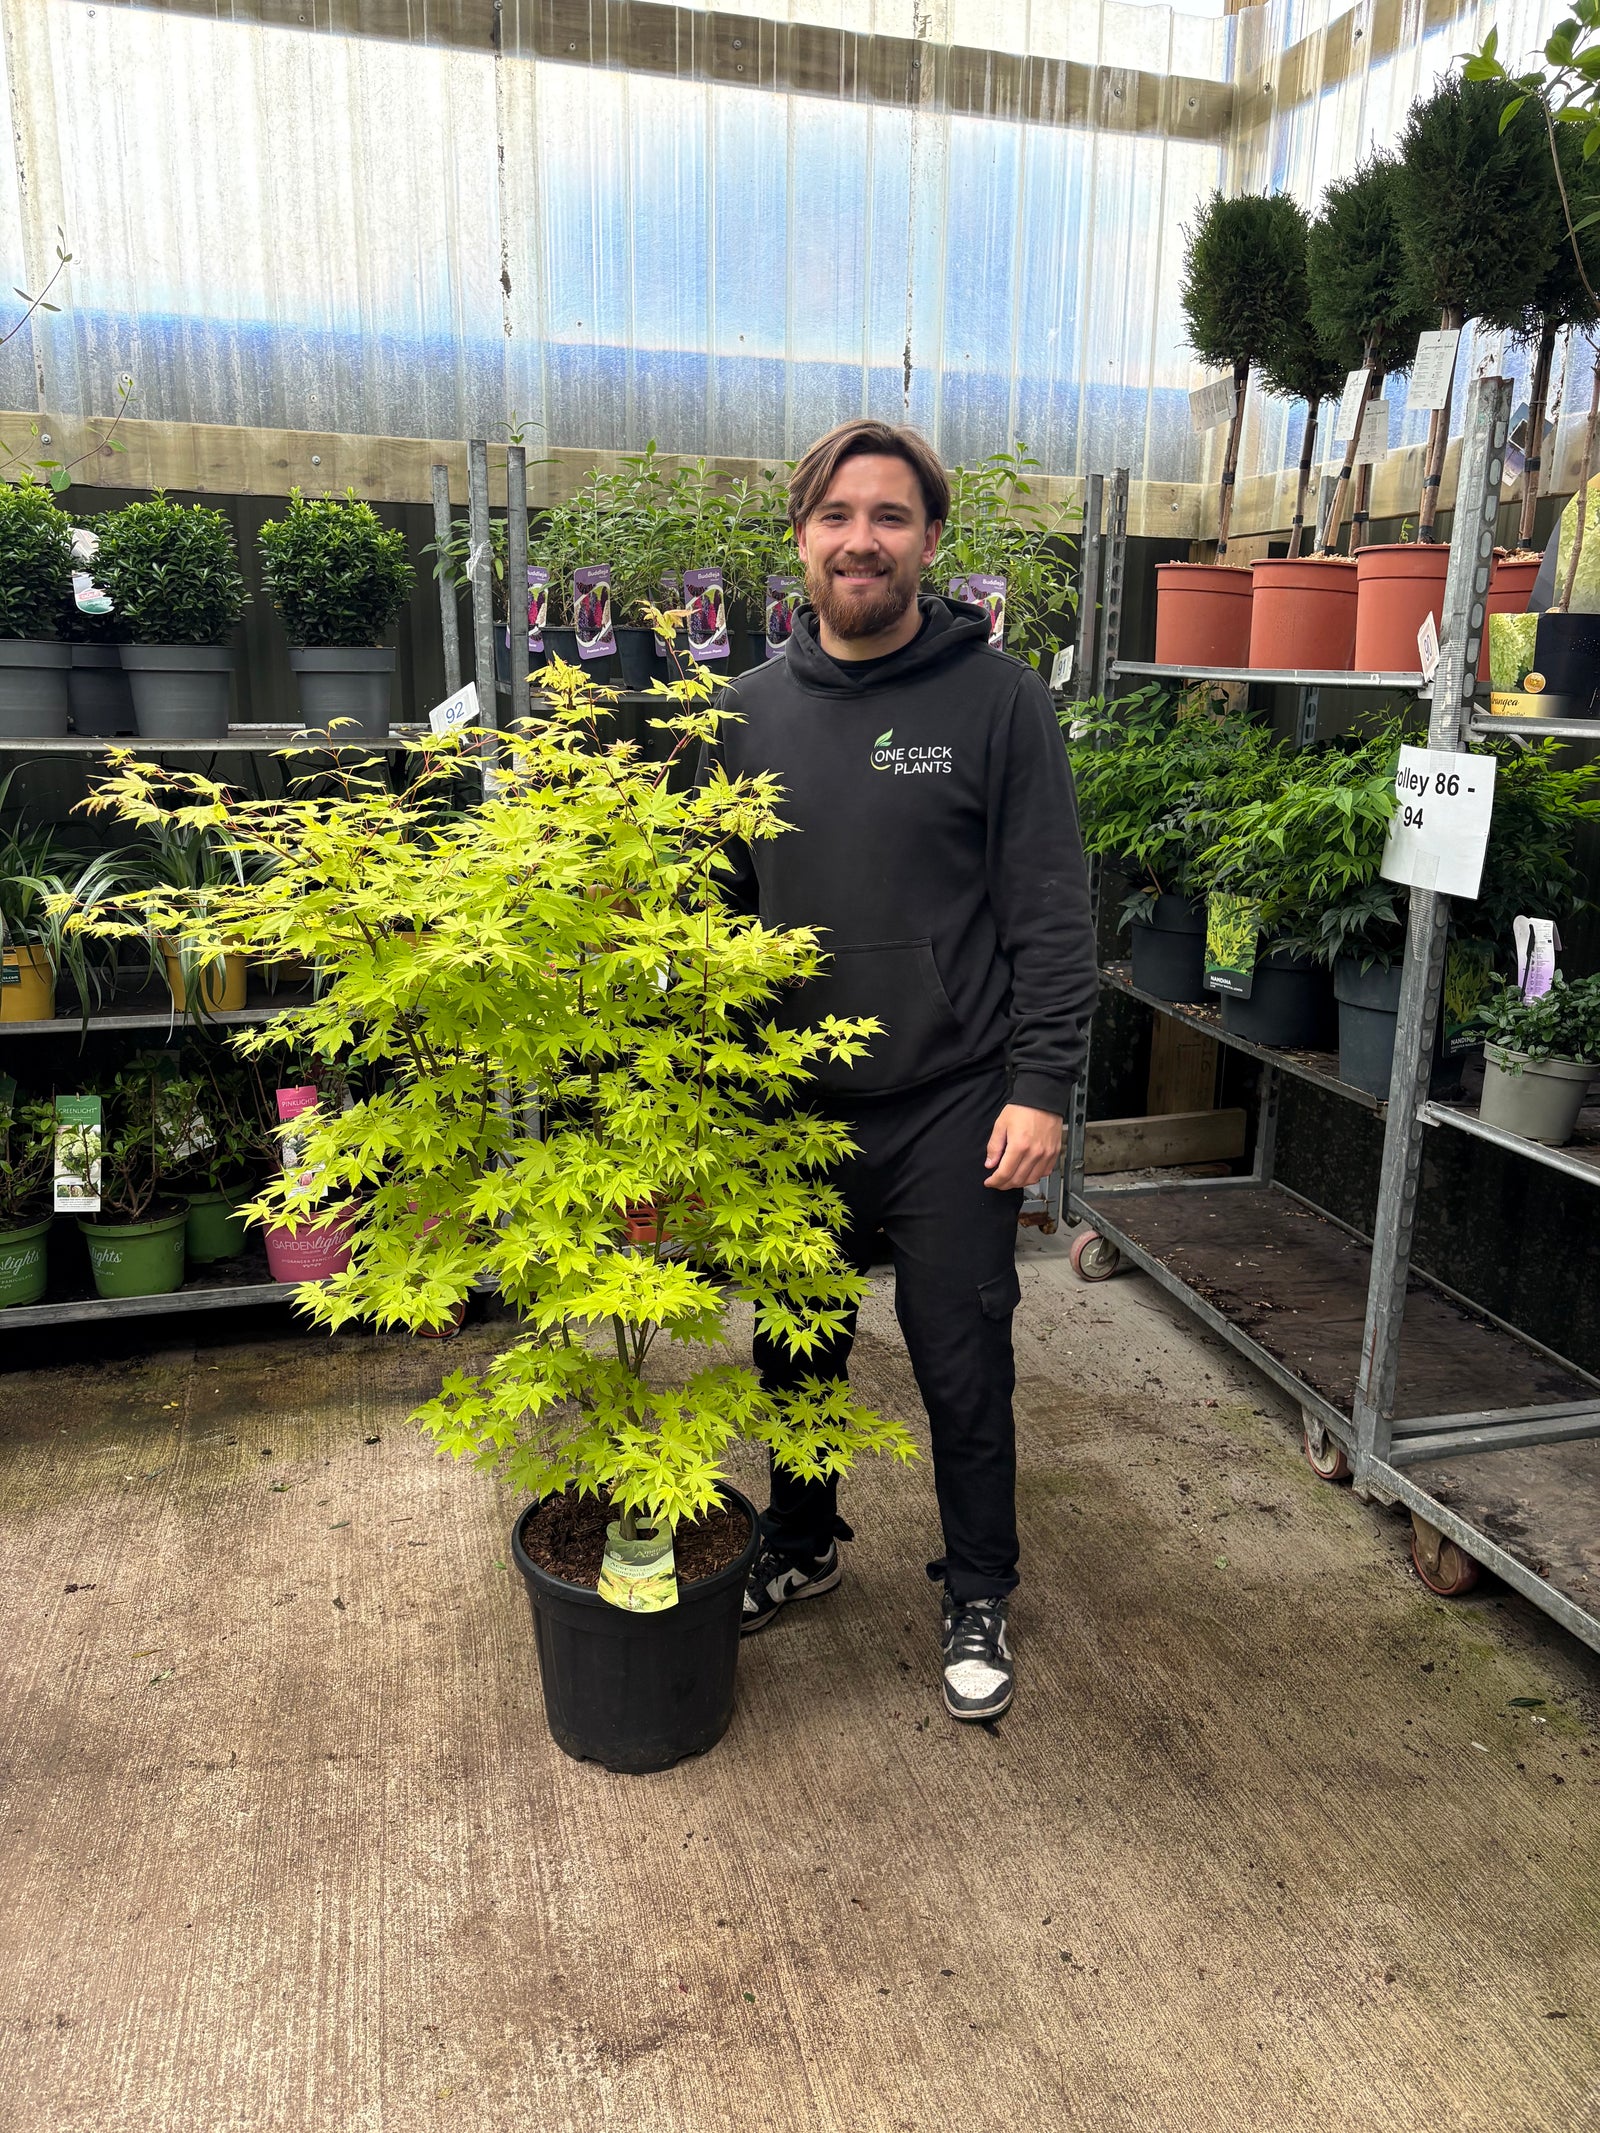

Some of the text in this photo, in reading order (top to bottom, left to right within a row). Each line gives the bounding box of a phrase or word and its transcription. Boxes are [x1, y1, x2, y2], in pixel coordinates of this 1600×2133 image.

[697, 571, 720, 580] Buddleja
[446, 701, 465, 724] 92
[875, 746, 953, 762] ONE CLICK
[894, 761, 952, 775] PLANTS
[1396, 766, 1430, 797] olley
[1435, 772, 1460, 796] 86
[1403, 805, 1424, 829] 94
